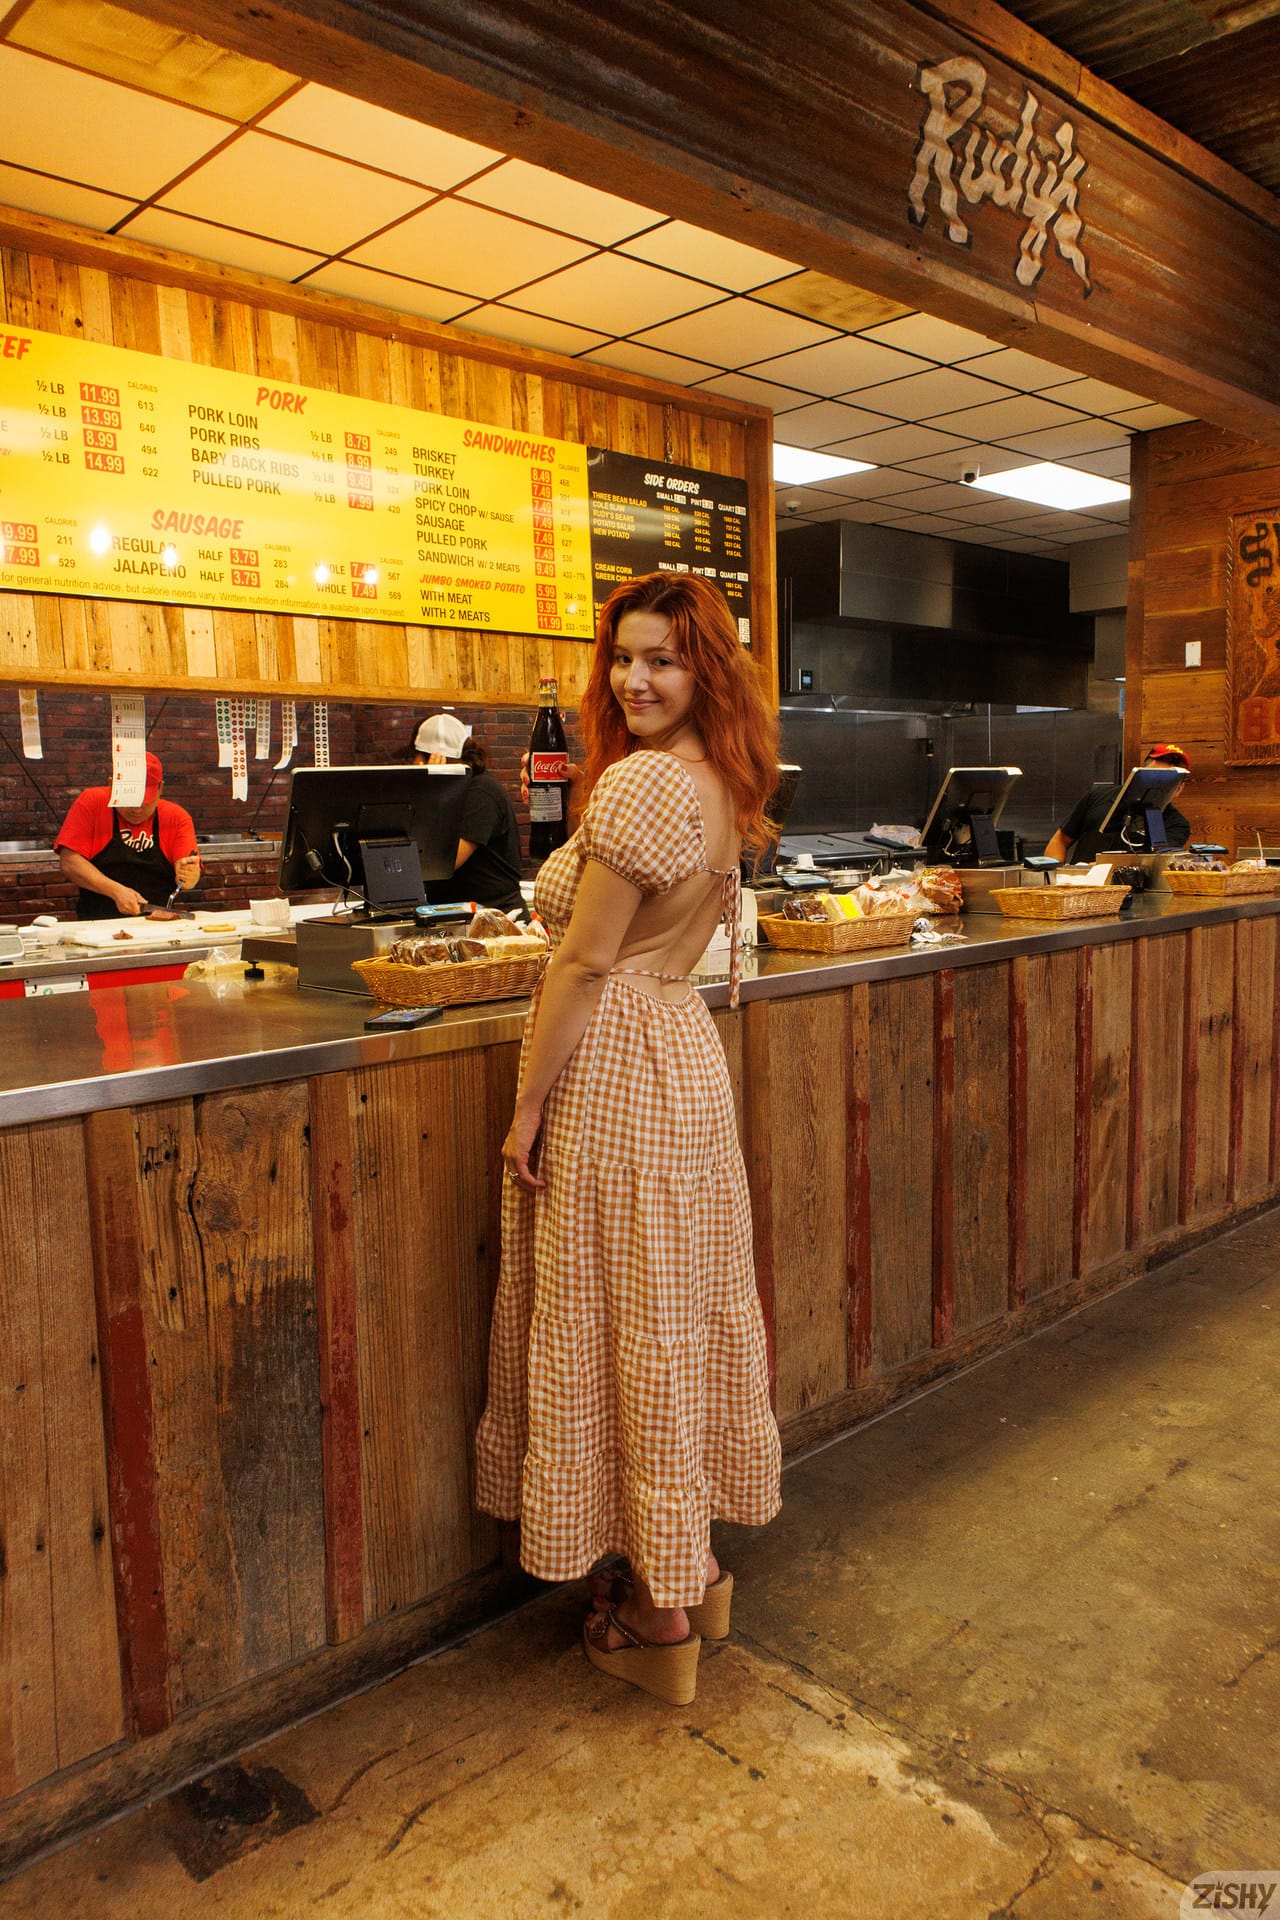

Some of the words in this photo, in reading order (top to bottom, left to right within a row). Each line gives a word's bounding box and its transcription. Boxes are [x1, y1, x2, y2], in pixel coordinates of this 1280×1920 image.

[0, 333, 32, 360] EF
[50, 382, 65, 395] LB
[81, 384, 118, 405] 11.99
[128, 381, 158, 393] CALORIES
[137, 400, 155, 411] 613
[256, 386, 308, 415] PORK
[52, 405, 67, 418] LB
[83, 408, 119, 428] 13.99
[188, 405, 225, 424] PORK
[228, 412, 259, 430] LOIN
[54, 428, 69, 441] LB
[85, 431, 115, 449] 8.99
[190, 426, 226, 445] PORK
[230, 433, 260, 451] RIBS
[321, 432, 333, 443] LB
[346, 434, 369, 450] 8.79
[463, 429, 556, 463] SANDWICHES
[141, 444, 158, 455] 494
[55, 452, 70, 464] LB
[87, 454, 123, 472] 14.99
[191, 448, 227, 465] BABY
[232, 455, 267, 473] BACK
[270, 462, 300, 479] RIBS
[322, 452, 334, 463] LB
[347, 454, 370, 470] 8.99
[412, 447, 457, 465] BRISKET
[532, 469, 550, 484] 8.49
[142, 467, 159, 477] 622
[413, 463, 455, 481] TURKEY
[533, 484, 551, 499] 7.49
[193, 470, 243, 490] PULLED
[247, 479, 281, 495] PORK
[643, 473, 665, 487] SIDE
[666, 477, 700, 495] ORDERS
[324, 493, 336, 504] LB
[350, 494, 373, 510] 7.99
[414, 480, 443, 496] PORK
[446, 486, 470, 500] LOIN
[534, 499, 552, 514] 7.49
[592, 491, 611, 501] THREE
[612, 494, 628, 504] BEAN
[628, 498, 648, 508] SALAD
[592, 500, 608, 510] COLE
[415, 497, 446, 512] SPICY
[449, 502, 477, 517] CHOP
[535, 515, 553, 530] 7.49
[718, 503, 735, 512] QUART
[44, 516, 78, 527] CALORIES
[151, 509, 245, 540] SAUSAGE
[416, 514, 465, 532] SAUSAGE
[535, 531, 554, 546] 7.49
[4, 523, 36, 542] 9.99
[56, 535, 73, 546] 211
[608, 529, 630, 540] POTATO
[7, 546, 37, 565] 7.99
[416, 530, 457, 547] PULLED
[459, 537, 488, 551] PORK
[536, 547, 554, 561] 7.49
[58, 558, 76, 569] 529
[199, 549, 224, 562] HALF
[232, 549, 258, 566] 3.79
[273, 559, 288, 569] 283
[418, 549, 474, 567] SANDWICH
[489, 561, 494, 570] 2
[495, 563, 521, 573] MEATS
[536, 563, 555, 577] 9.49
[17, 575, 52, 586] general
[54, 578, 89, 589] nutrition
[126, 584, 140, 594] but
[200, 570, 225, 583] HALF
[233, 570, 259, 586] 3.79
[720, 571, 737, 579] QUART
[316, 583, 347, 595] WHOLE
[353, 583, 376, 598] 7.49
[419, 574, 453, 586] JUMBO
[455, 578, 492, 591] SMOKED
[494, 582, 526, 594] POTATO
[537, 585, 556, 598] 5.99
[420, 589, 445, 601] WITH
[447, 593, 473, 605] MEAT
[538, 601, 556, 614] 9.99
[421, 606, 447, 618] WITH
[449, 609, 455, 619] 2
[458, 610, 491, 622] MEATS
[539, 617, 561, 629] 11.99
